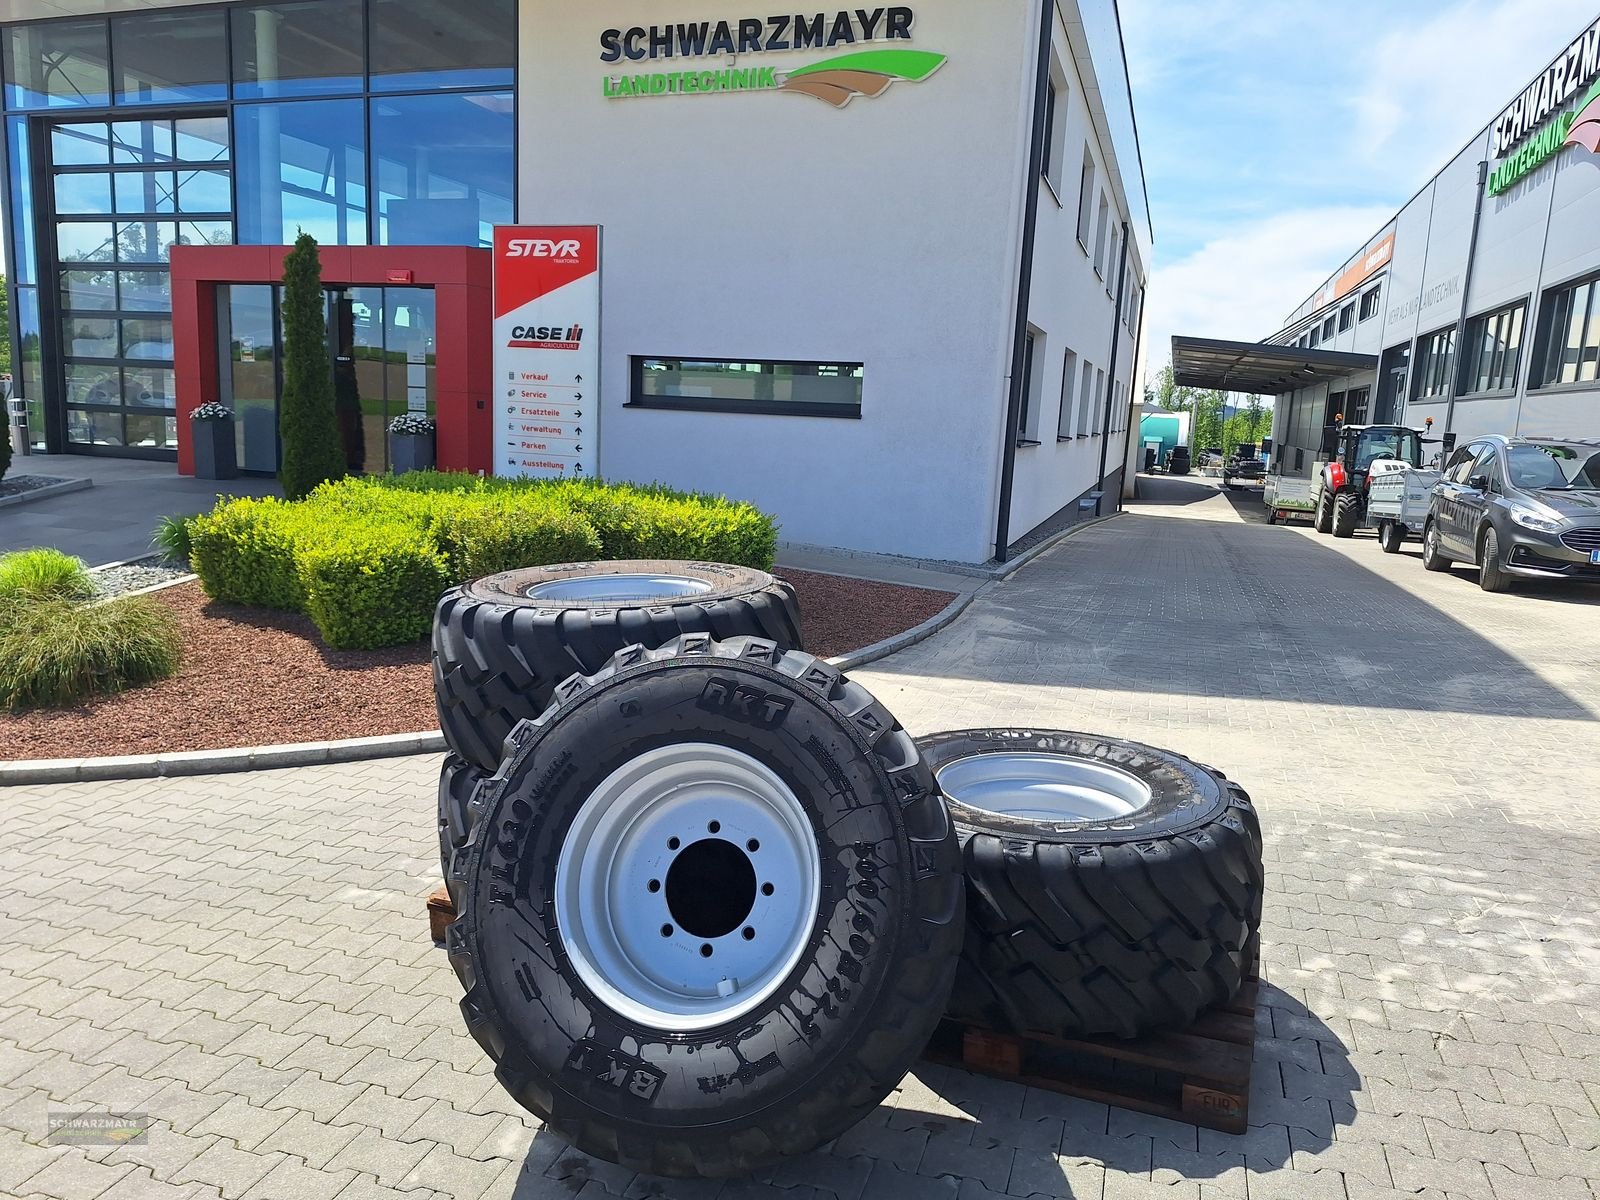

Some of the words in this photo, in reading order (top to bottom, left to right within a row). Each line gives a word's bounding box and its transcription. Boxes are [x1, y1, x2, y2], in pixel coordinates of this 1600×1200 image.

[600, 6, 914, 63] SCHWARZMAYR
[603, 66, 777, 98] LANDTECHNIK
[1492, 20, 1600, 160] SCHWARZM
[1487, 111, 1574, 198] LANDTECHNIK
[505, 239, 581, 258] STEYR
[511, 326, 563, 340] CASE
[521, 372, 549, 381] Verkauf
[521, 390, 547, 399] Service
[521, 407, 560, 417] Ersatzteile
[521, 424, 562, 435] Verwaltung
[521, 441, 547, 450] Parken
[521, 459, 565, 471] Ausstellung
[568, 1046, 663, 1101] BKT
